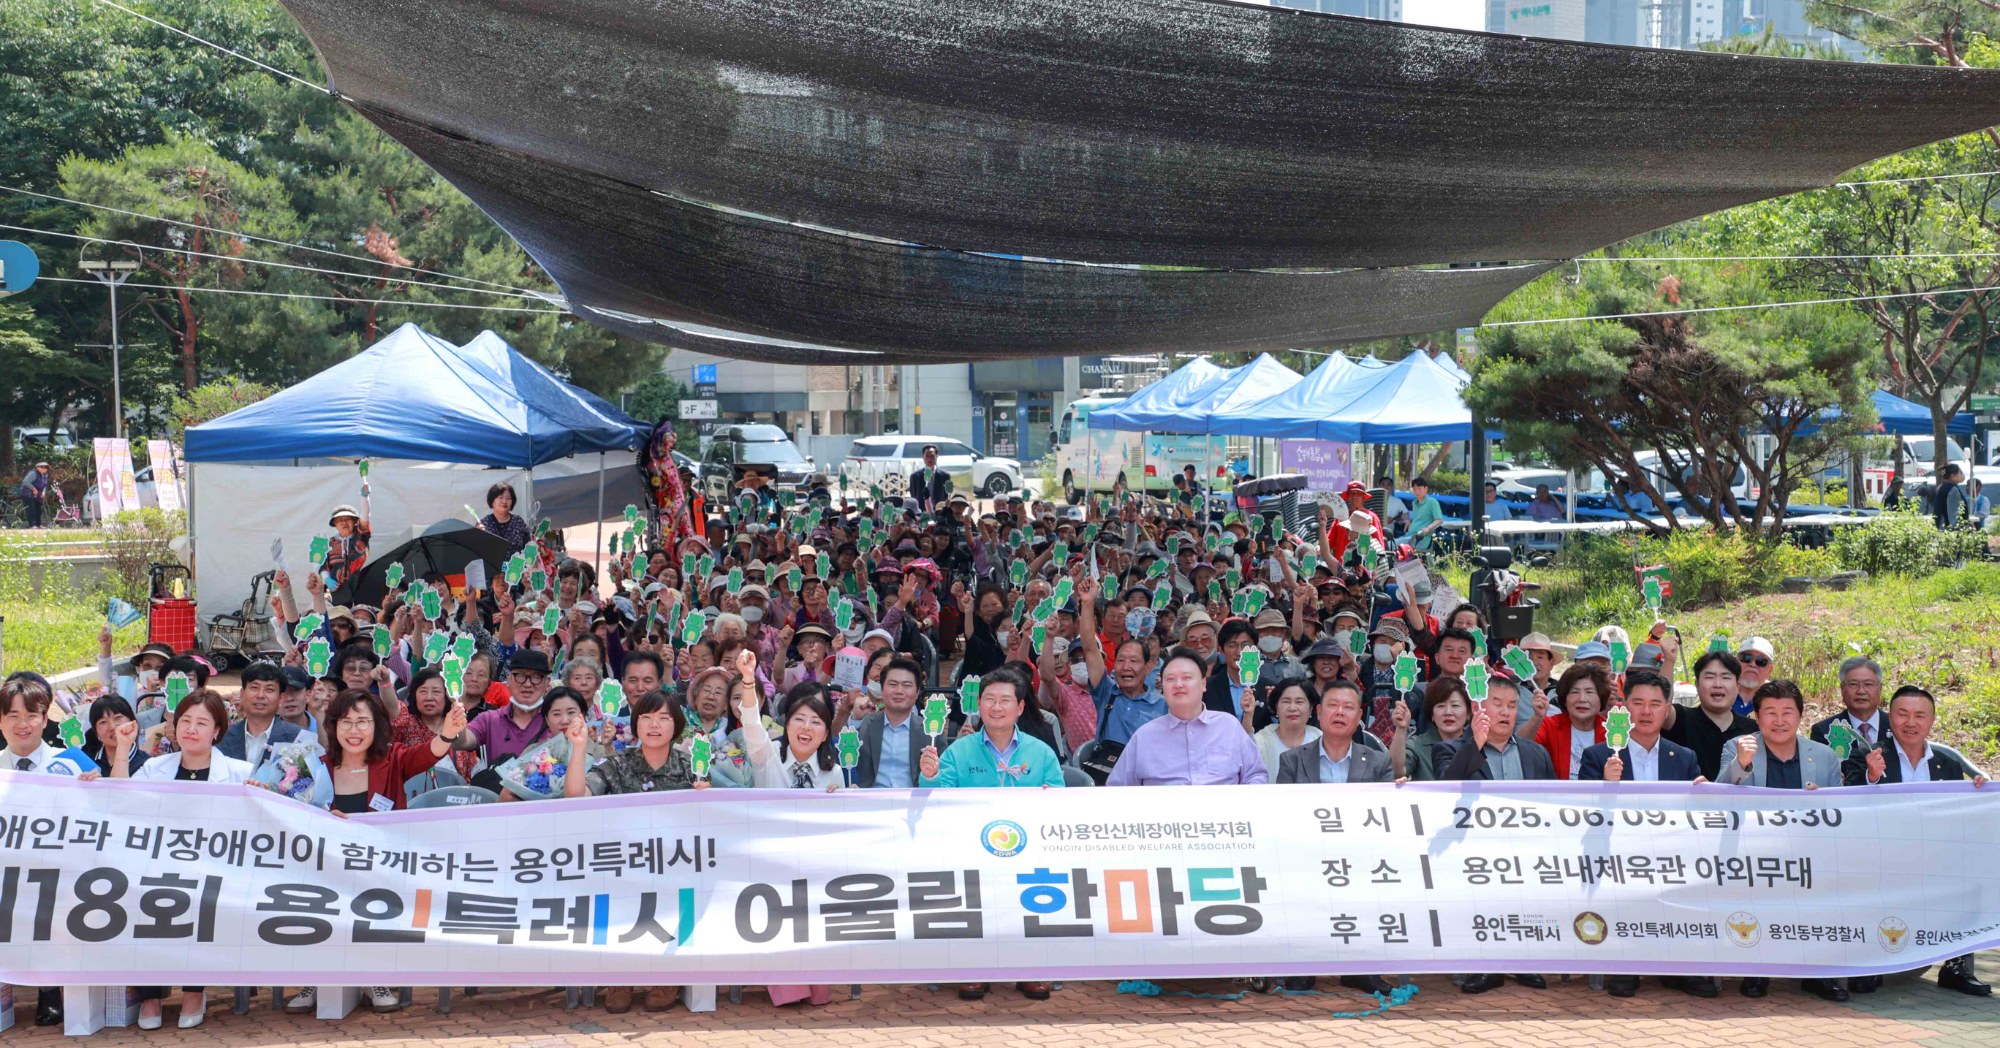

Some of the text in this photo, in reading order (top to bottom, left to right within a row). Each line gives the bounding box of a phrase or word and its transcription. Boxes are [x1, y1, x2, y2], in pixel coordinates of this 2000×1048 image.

[684, 404, 697, 415] 2F
[1040, 821, 1254, 841] (사)용인신체장애인복지회
[1313, 806, 1843, 833] 일 시 2025. 06. 09. (월) 13:30
[125, 825, 326, 870] 비장애인이
[340, 842, 498, 884] 함께하는
[510, 835, 717, 884] 용인특례시!
[1042, 844, 1082, 852] YONGIN
[1138, 843, 1184, 851] WELFARE
[1187, 842, 1256, 850] ASSOCIATION
[1321, 854, 1812, 889] 장 소 용인 실내체육관 야외무대
[0, 866, 1268, 947] 18회 용인특례시 어울림 한마당
[1330, 912, 1561, 944] 후 원 용인특례시
[1615, 921, 1719, 940] 용인특례시의회
[1768, 923, 1866, 943] 용인동부경찰서
